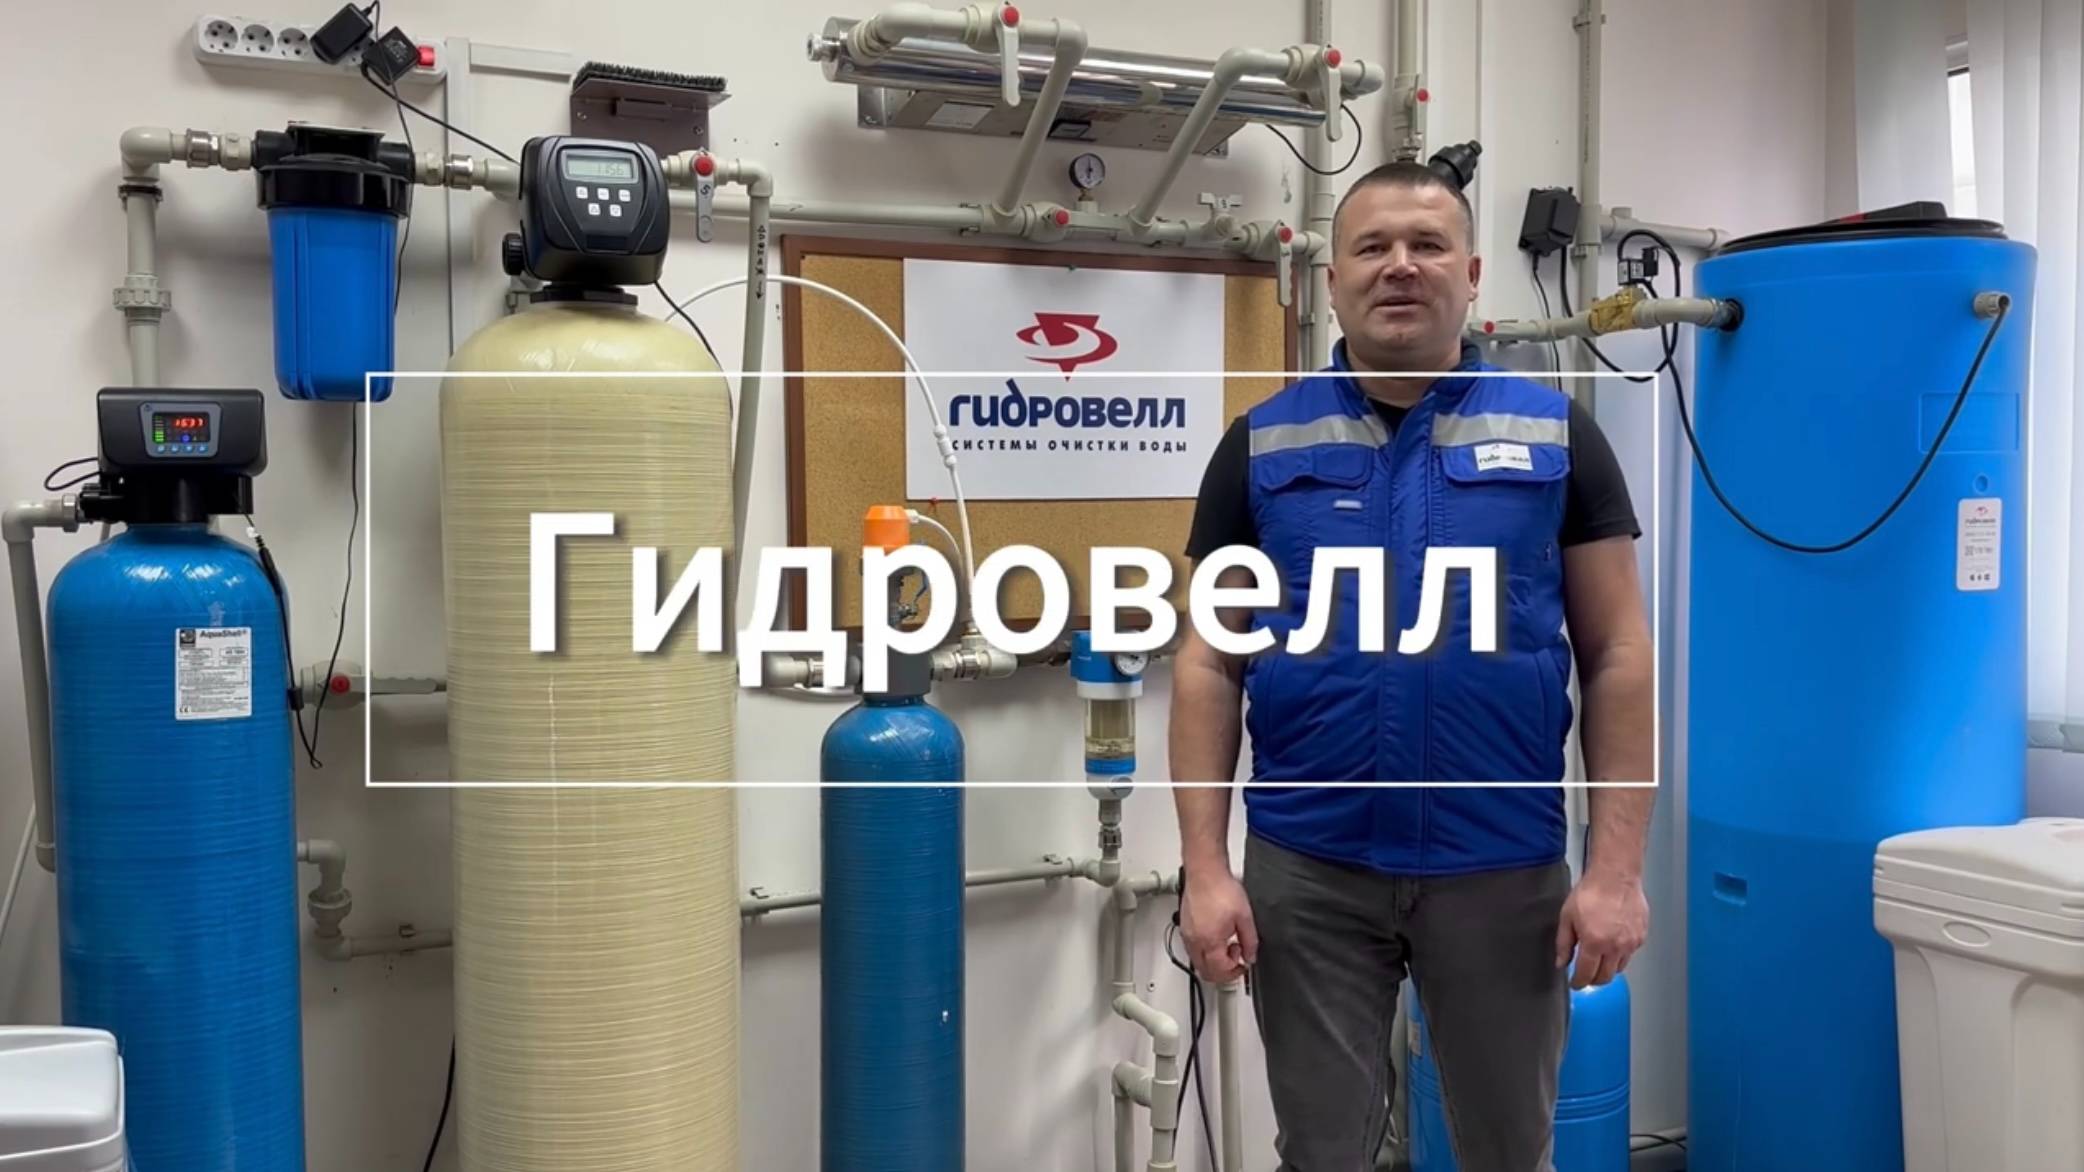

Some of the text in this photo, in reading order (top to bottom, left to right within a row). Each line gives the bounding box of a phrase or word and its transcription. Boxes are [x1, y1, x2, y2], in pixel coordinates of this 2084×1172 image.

[949, 378, 1186, 428] гидровелл
[952, 439, 1187, 453] СИСТЕМЫ ОЧИСТКИ ВОДЫ
